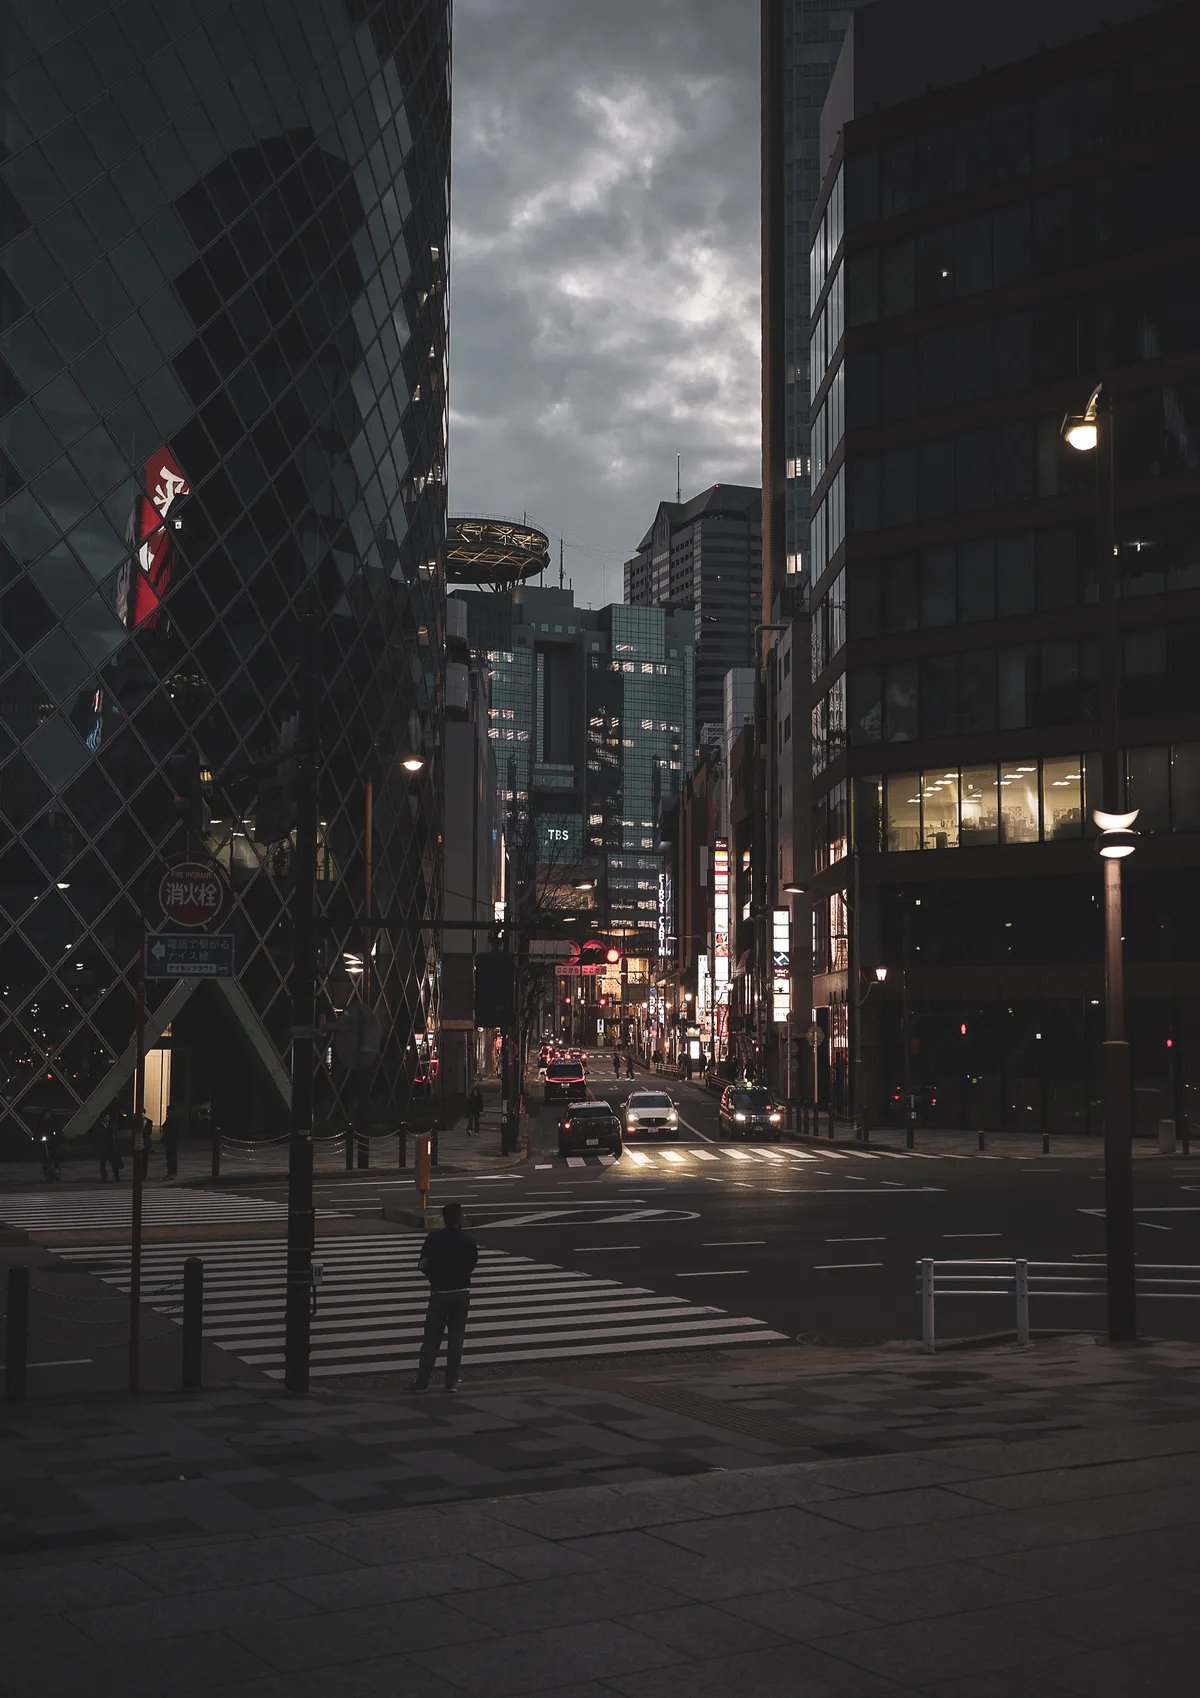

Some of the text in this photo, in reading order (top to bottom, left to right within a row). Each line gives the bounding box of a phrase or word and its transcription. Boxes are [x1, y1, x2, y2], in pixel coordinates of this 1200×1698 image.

[548, 829, 569, 841] TBS
[166, 882, 217, 906] 消火栓
